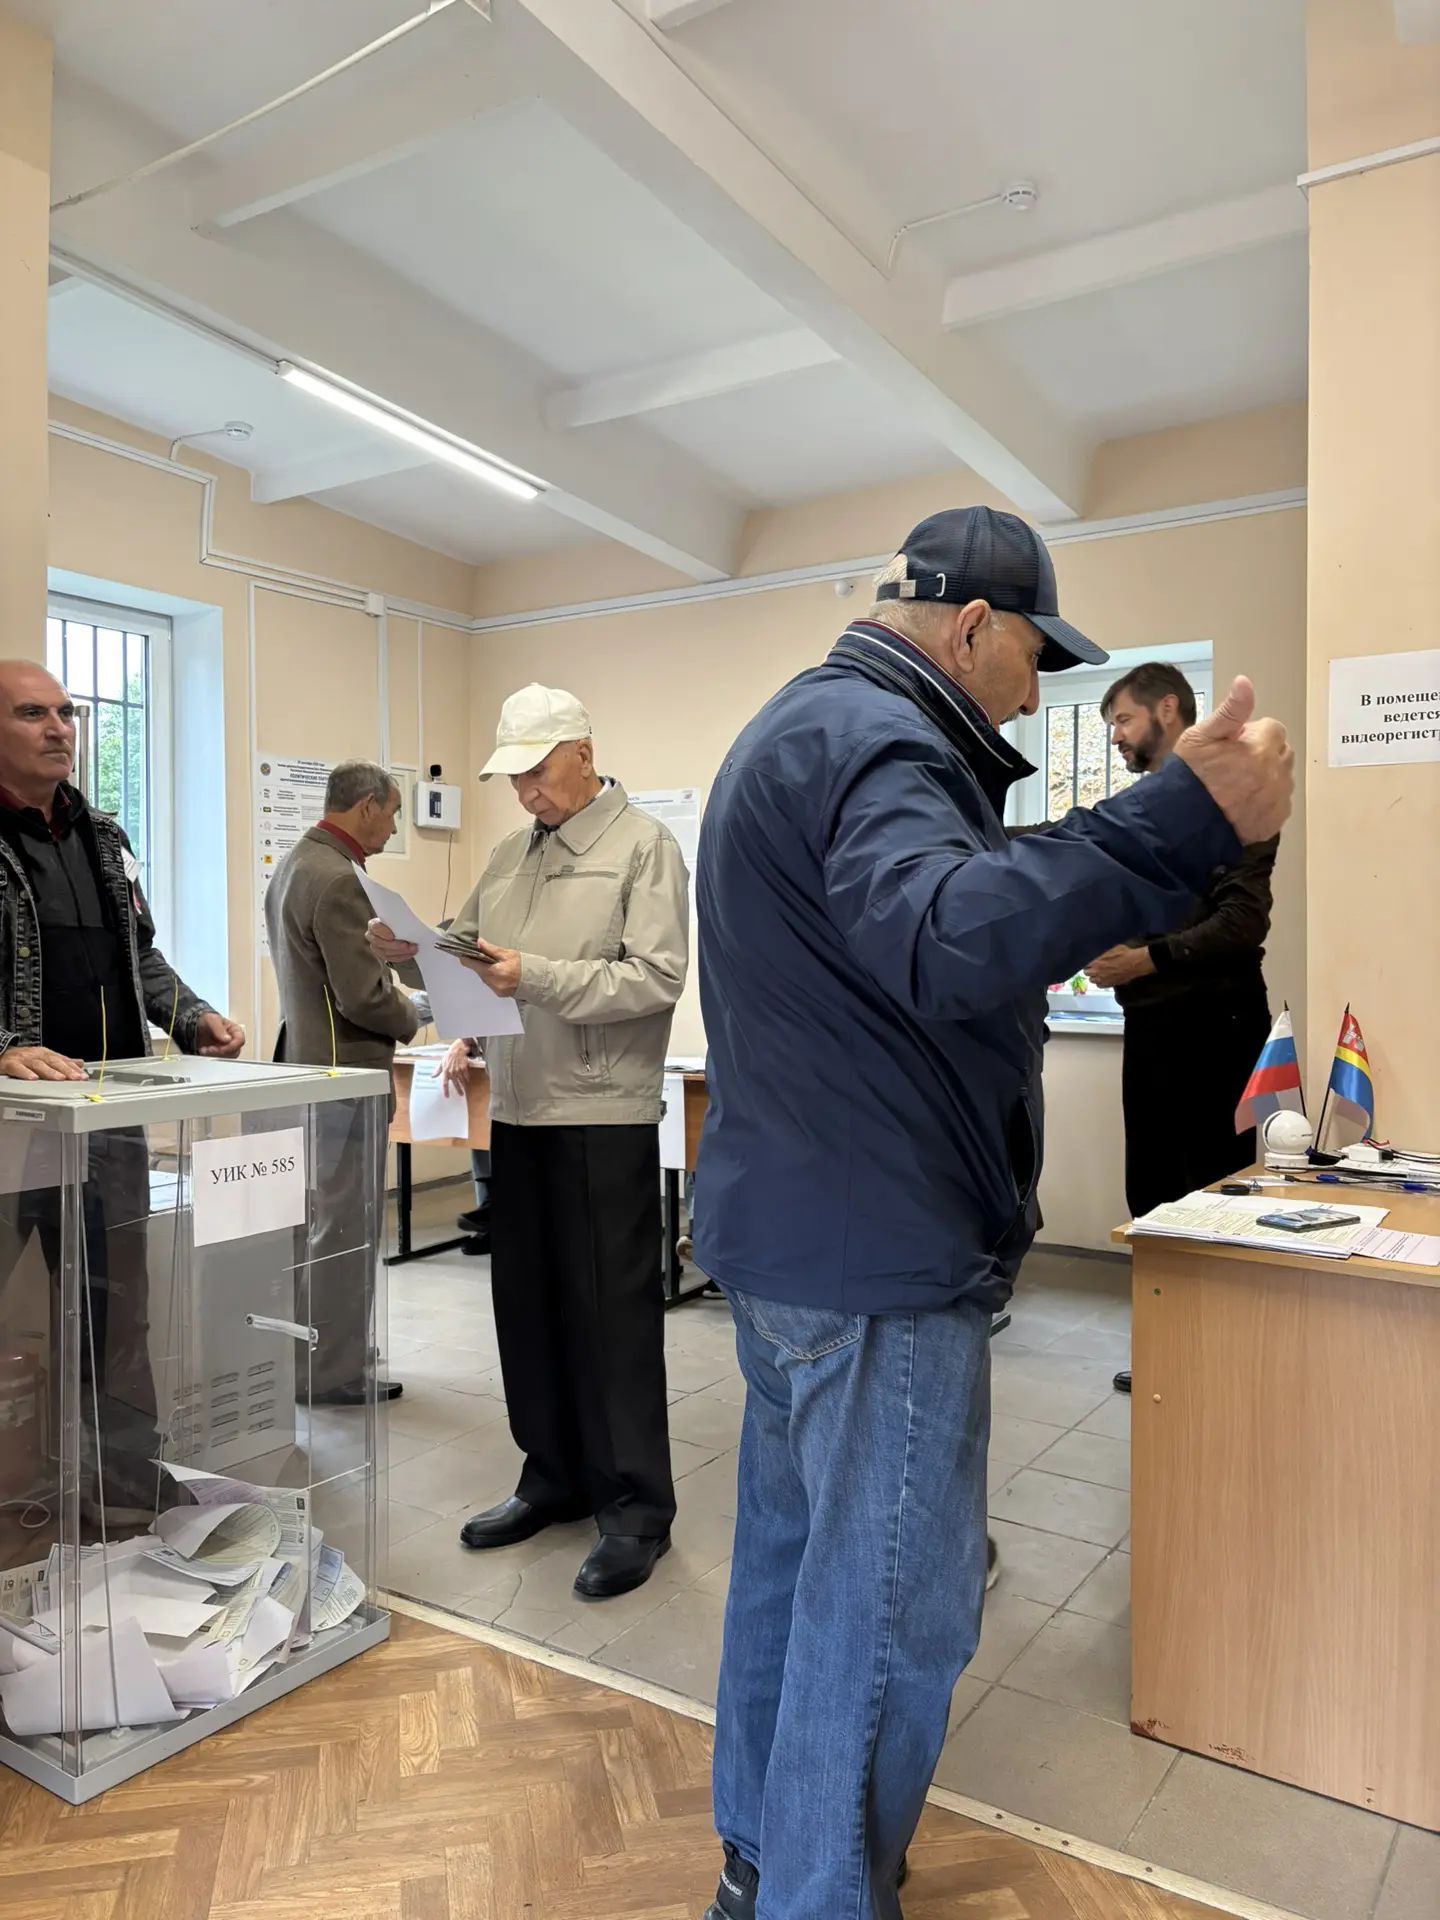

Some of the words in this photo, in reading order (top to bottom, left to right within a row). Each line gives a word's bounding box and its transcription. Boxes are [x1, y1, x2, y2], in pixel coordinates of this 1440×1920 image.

[1360, 694, 1372, 706] В
[1376, 690, 1440, 705] помеще
[1383, 710, 1440, 723] ведется
[1341, 728, 1440, 744] видеорегист
[209, 1164, 247, 1185] УИК
[250, 1161, 267, 1178] №
[271, 1156, 295, 1175] 585
